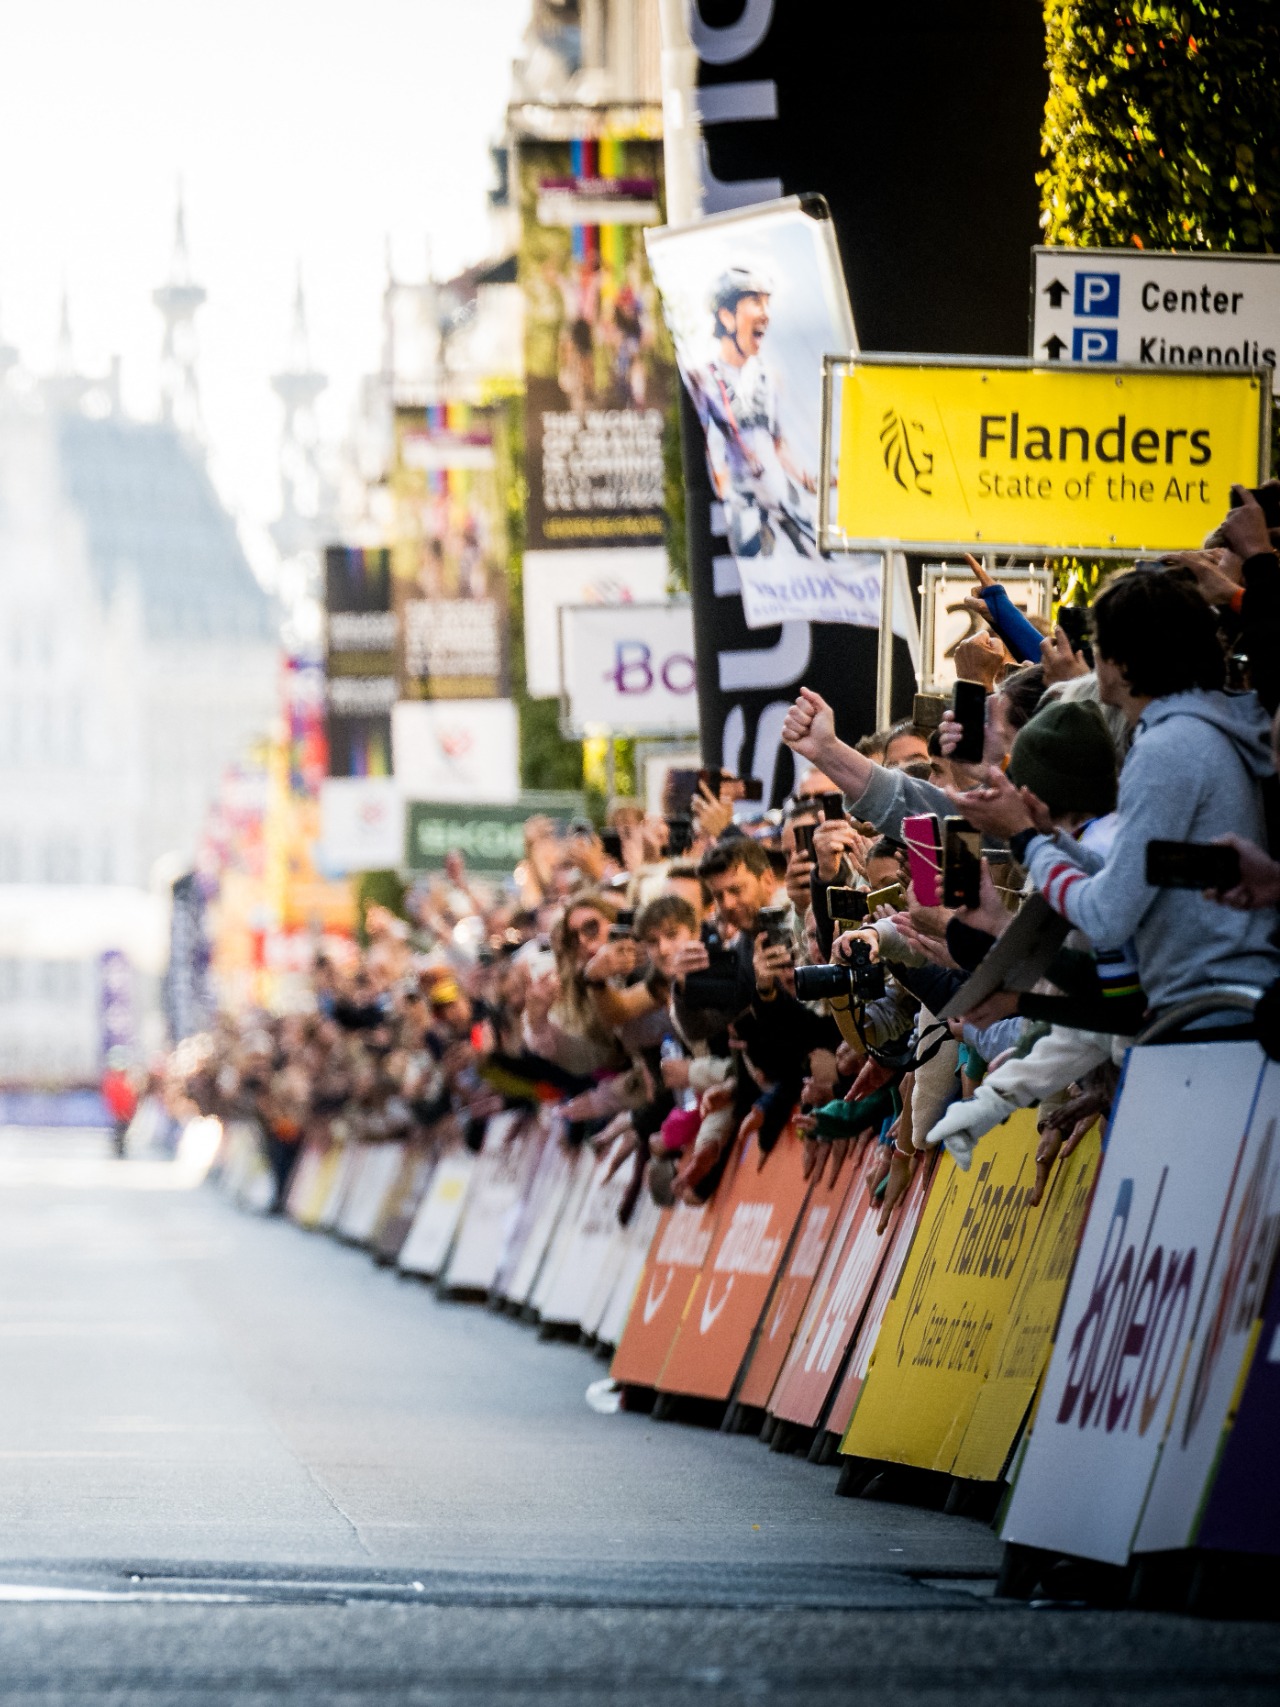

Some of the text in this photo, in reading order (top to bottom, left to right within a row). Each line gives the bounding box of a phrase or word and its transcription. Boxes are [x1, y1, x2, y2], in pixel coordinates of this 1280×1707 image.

[1141, 280, 1243, 315] Center
[1140, 337, 1276, 368] Kinepolis
[978, 410, 1212, 466] Flanders
[977, 470, 1211, 504] State of the Art
[1057, 1165, 1197, 1438] Bolero
